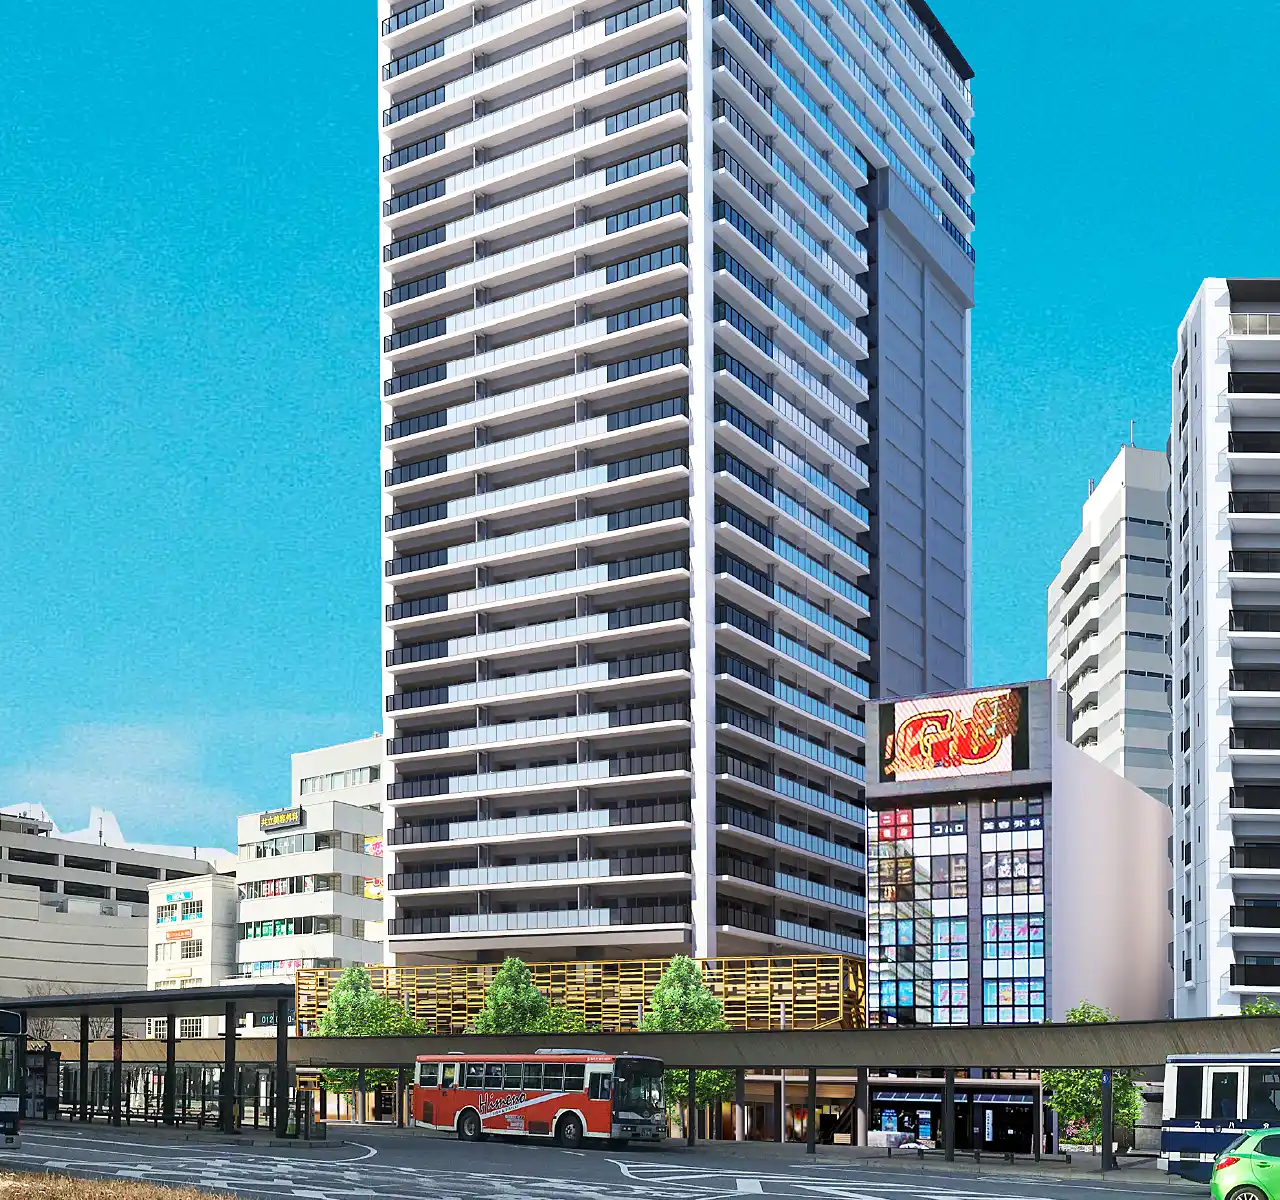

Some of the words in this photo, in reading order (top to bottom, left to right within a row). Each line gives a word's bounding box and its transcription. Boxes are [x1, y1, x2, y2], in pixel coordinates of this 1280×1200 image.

[934, 823, 964, 834] コムロ
[479, 1092, 527, 1116] Himeno
